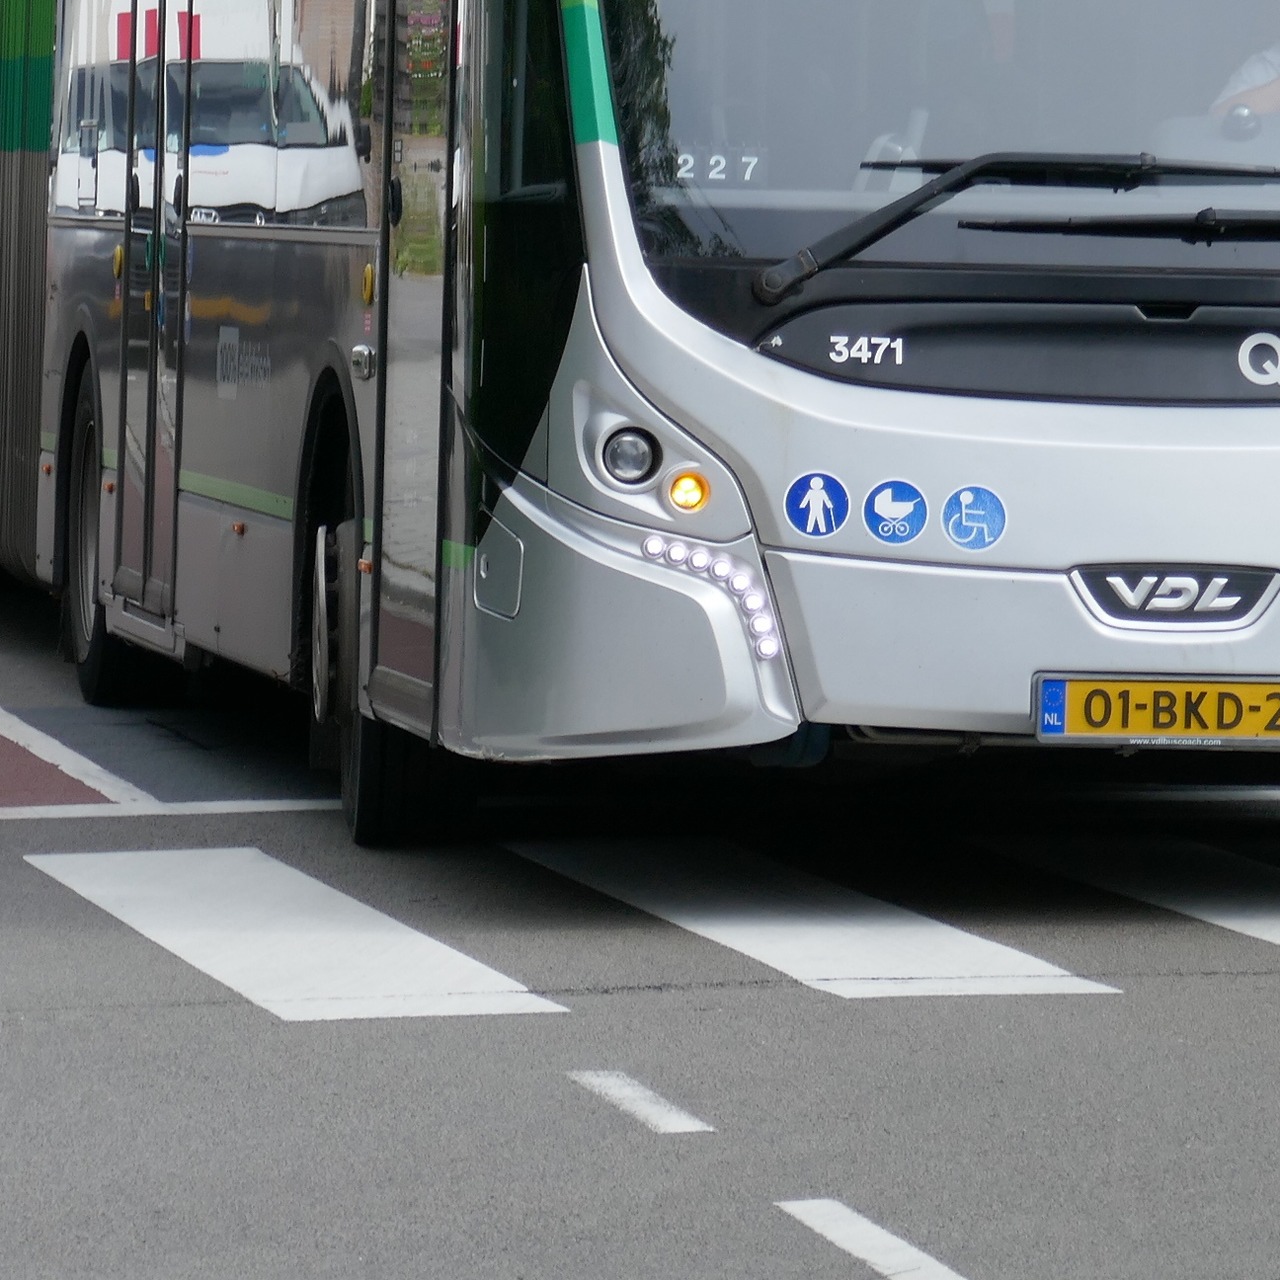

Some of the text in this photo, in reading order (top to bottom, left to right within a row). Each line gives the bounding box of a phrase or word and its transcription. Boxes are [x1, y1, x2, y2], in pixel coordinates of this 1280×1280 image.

[828, 335, 904, 365] 3471
[1105, 576, 1242, 612] VDL
[1044, 713, 1062, 726] NL
